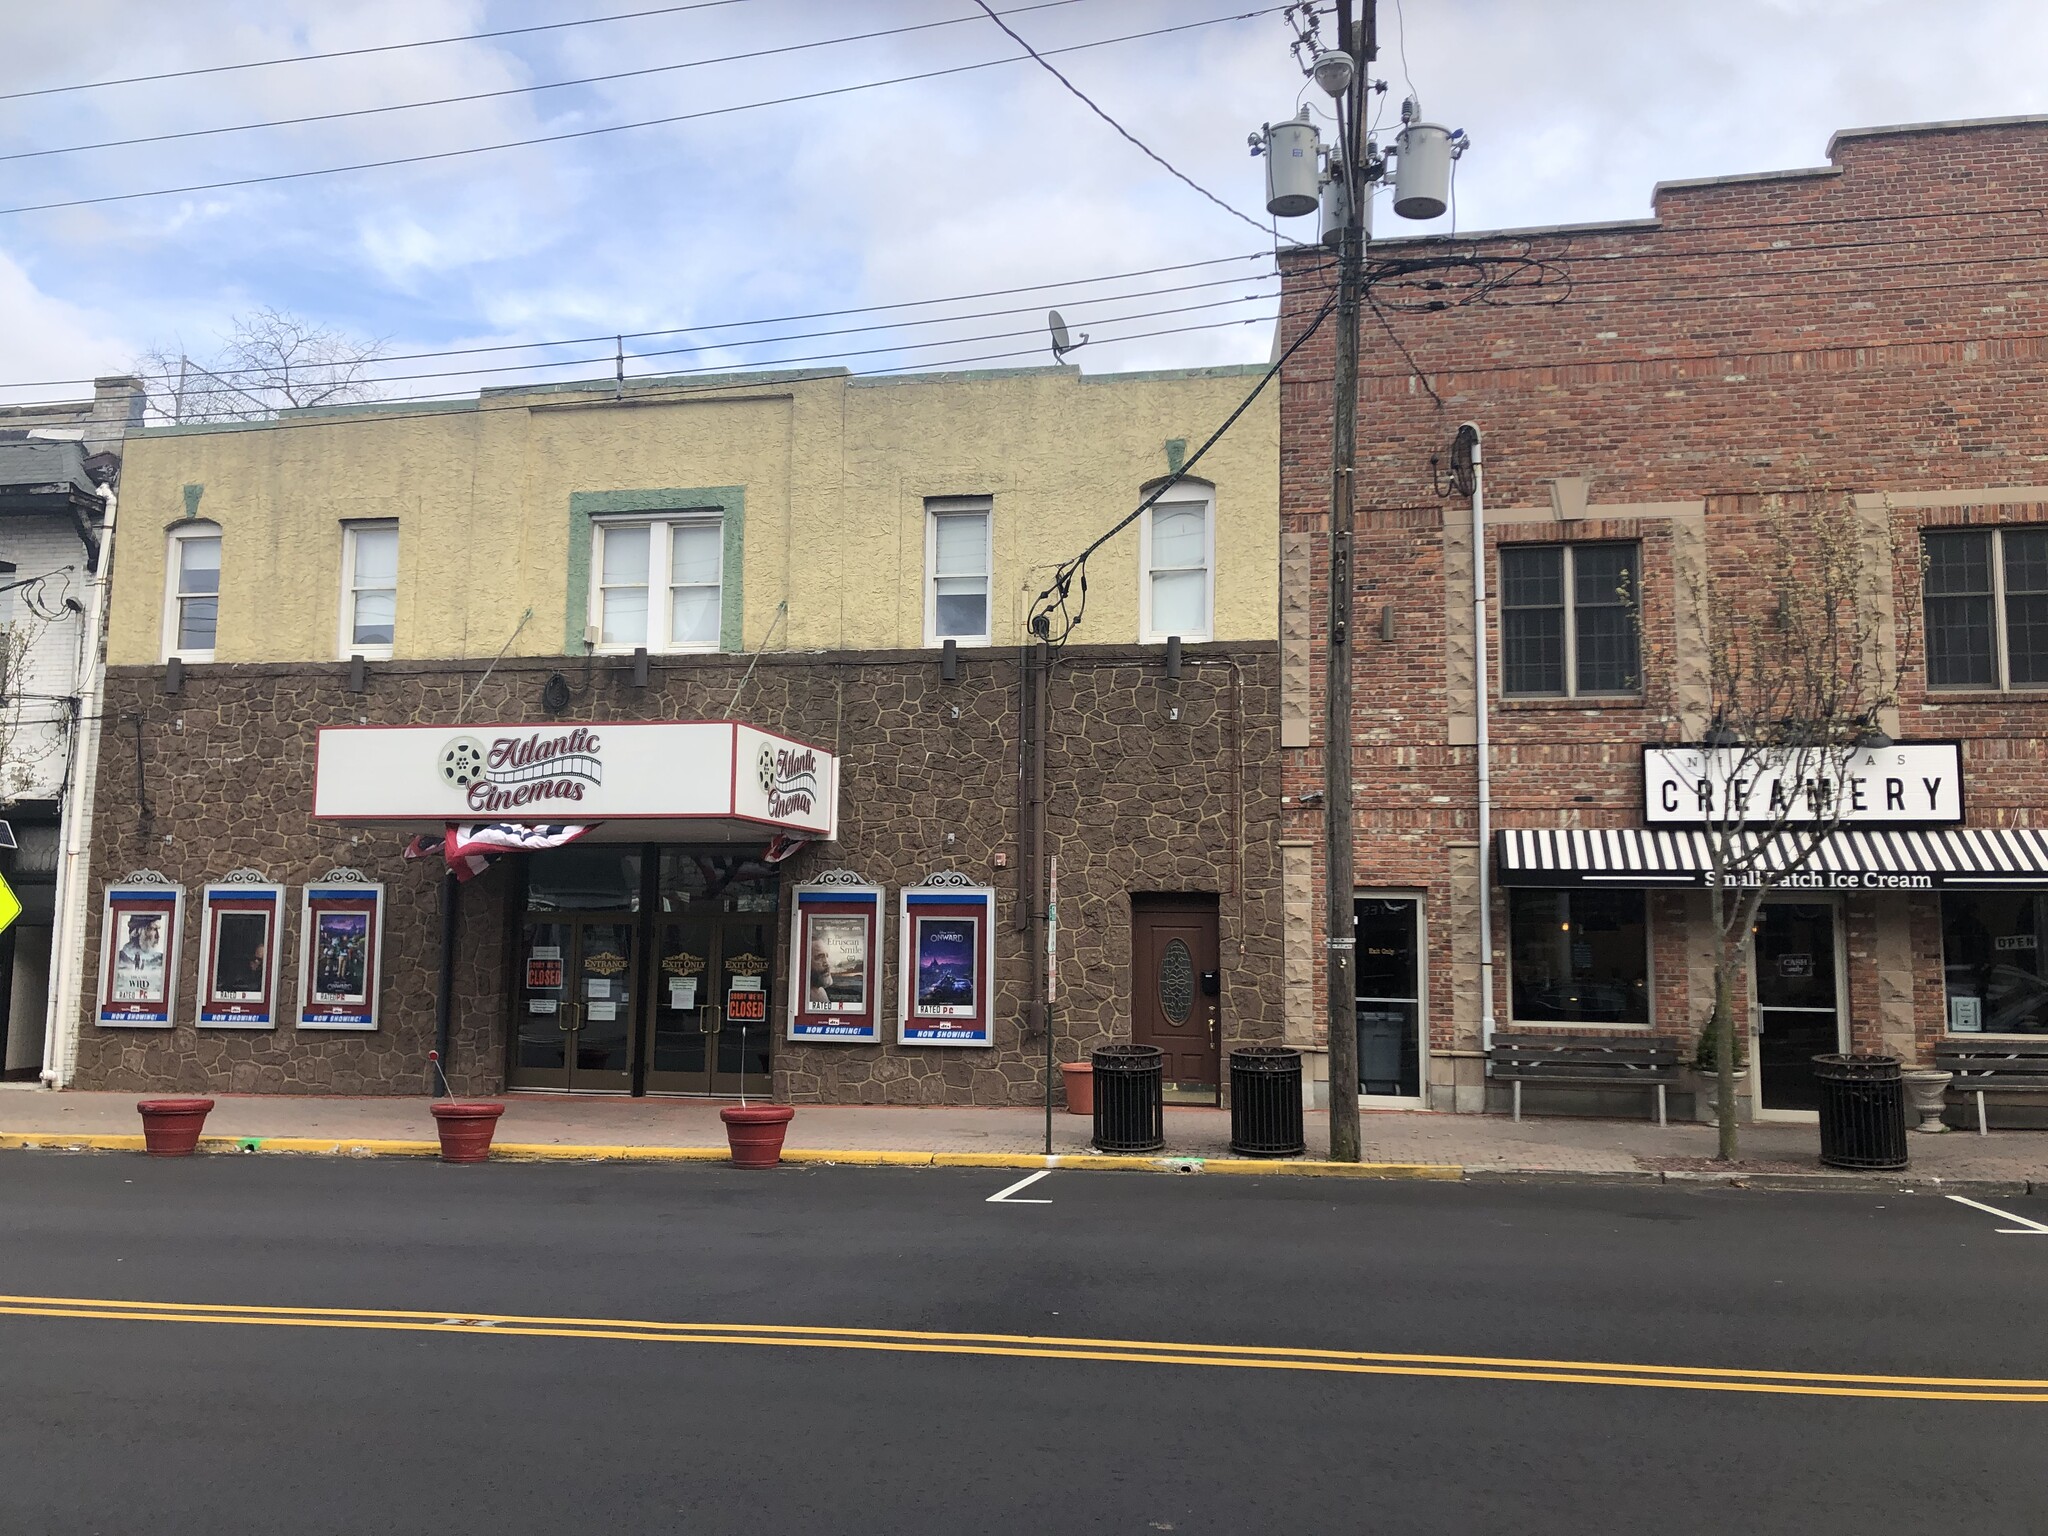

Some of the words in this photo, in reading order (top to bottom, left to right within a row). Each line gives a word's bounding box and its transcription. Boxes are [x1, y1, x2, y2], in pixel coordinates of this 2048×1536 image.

[487, 728, 601, 769] Atlantic
[776, 748, 817, 779] Atlantic
[465, 779, 586, 812] Cinemas
[1662, 777, 1942, 812] CREAMERY
[768, 788, 812, 818] Cinemas
[1829, 872, 1859, 887] Ice
[1863, 872, 1933, 888] Cream
[827, 938, 860, 946] Etruscan
[930, 934, 964, 943] ONWARD
[1998, 938, 2034, 948] OPEN
[839, 946, 862, 954] Smile
[584, 959, 628, 968] ENTRANCE
[662, 960, 684, 968] EXIT
[684, 960, 706, 969] ONLY
[725, 960, 746, 969] EXIT
[747, 960, 769, 969] ONLY
[529, 969, 561, 985] CLOSED
[730, 992, 747, 1000] SORRY
[729, 1001, 763, 1017] CLOSED
[812, 1002, 832, 1010] RATED
[838, 1001, 843, 1010] R
[920, 1005, 941, 1014] RATED
[805, 1026, 824, 1034] NOW
[825, 1026, 862, 1035] SHOWING!
[917, 1030, 934, 1038] NOW
[936, 1030, 974, 1039] SHOWING!
